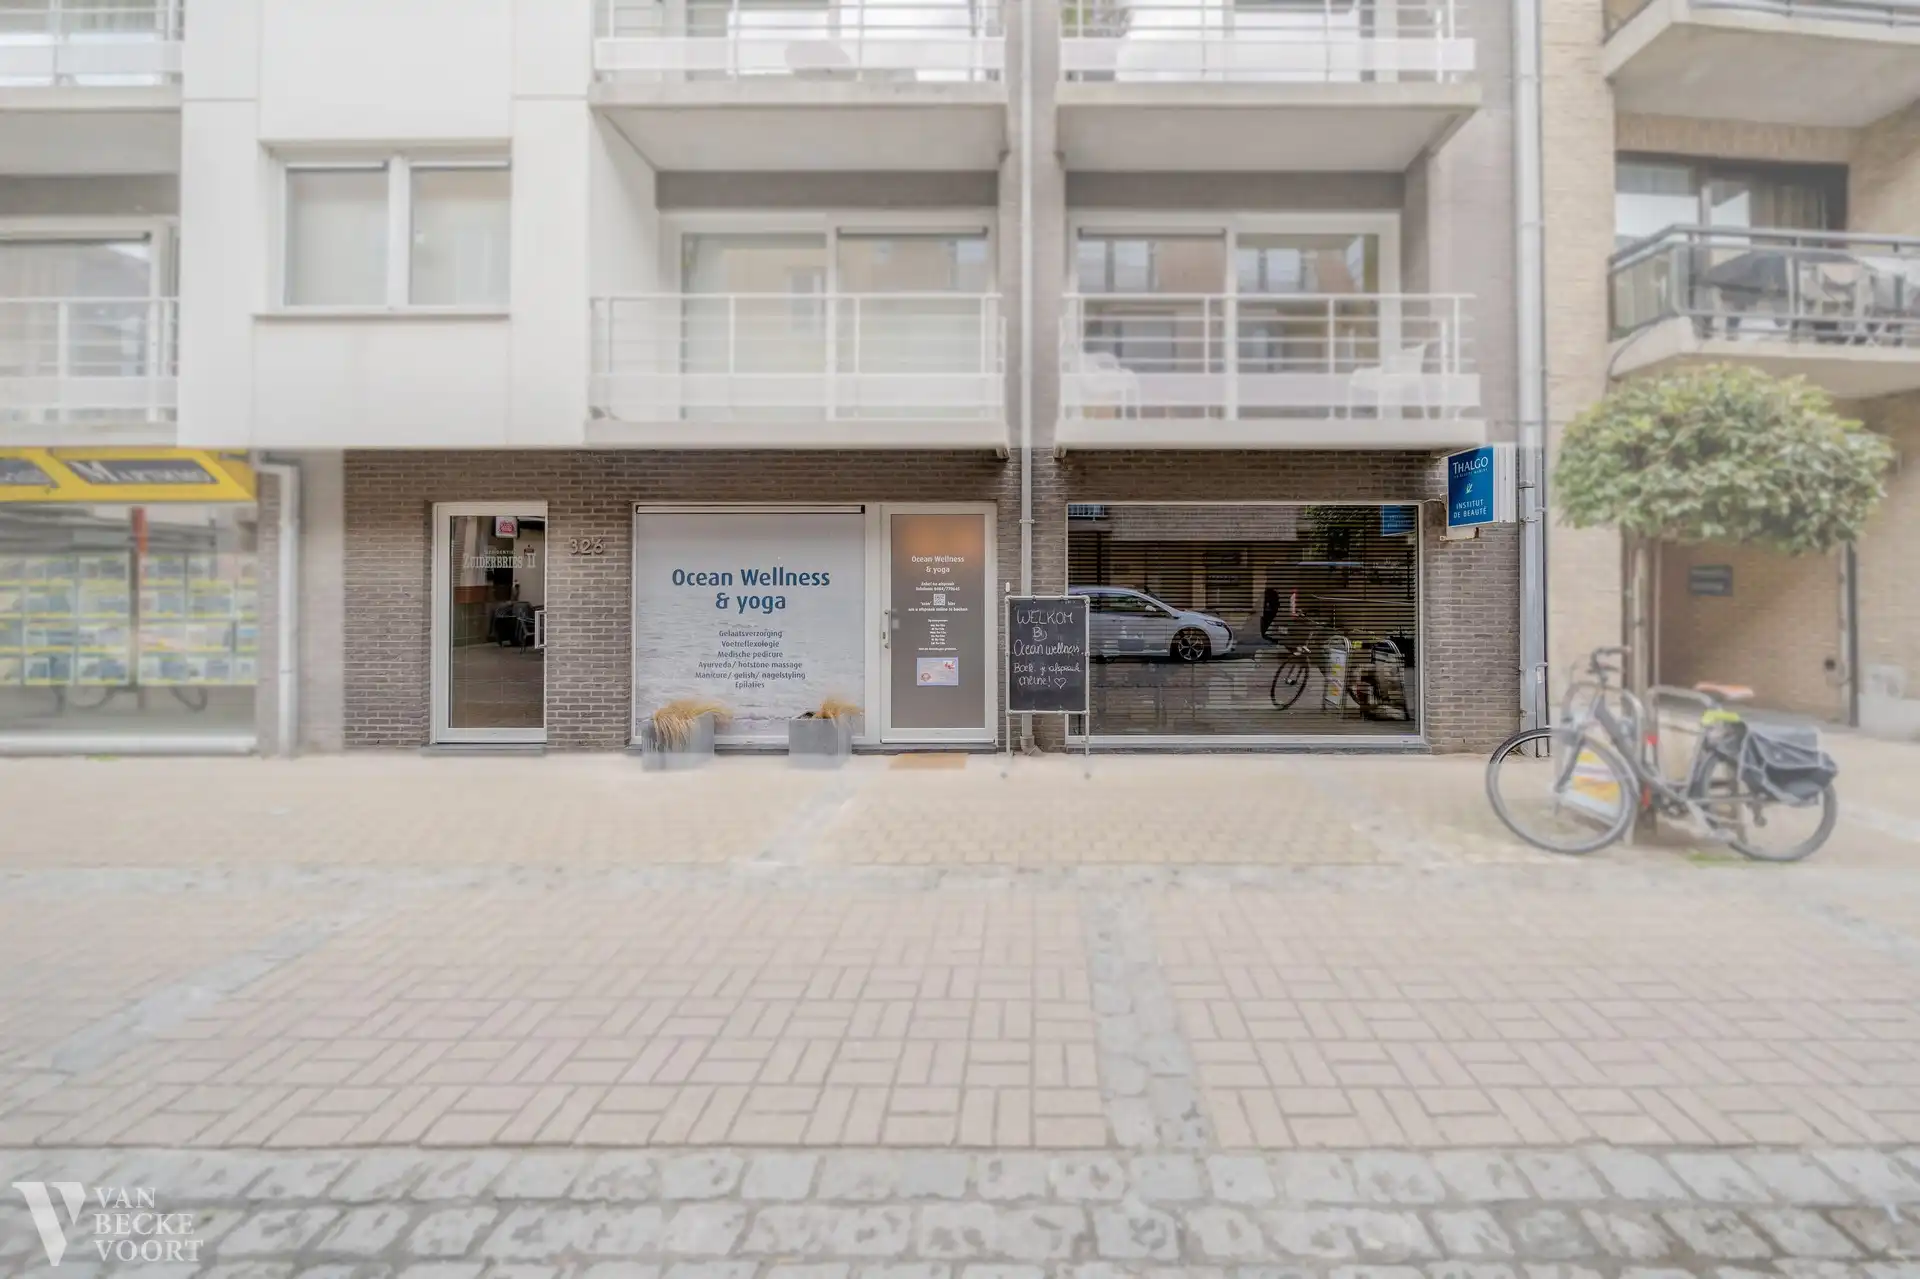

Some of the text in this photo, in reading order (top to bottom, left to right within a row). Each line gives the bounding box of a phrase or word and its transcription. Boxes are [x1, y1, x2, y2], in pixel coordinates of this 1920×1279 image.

[1453, 456, 1488, 475] THALGO
[1456, 499, 1483, 509] INSTITUT
[1463, 506, 1487, 517] BEAUTÉ
[569, 538, 605, 555] 326
[911, 554, 965, 563] Ocean Wellness
[925, 565, 950, 575] & yoga
[672, 566, 830, 586] Ocean Wellness
[716, 592, 786, 614] & yoga
[1017, 609, 1074, 625] WELKOM
[718, 630, 783, 638] Gelaatsverzorging
[721, 640, 780, 648] Voetreflexologie
[1013, 639, 1080, 656] Ocean wellness
[752, 651, 784, 659] pedicure
[698, 661, 737, 669] Ayurveda/
[734, 671, 760, 680] gelish/
[762, 671, 806, 680] nagelstyling
[735, 681, 765, 689] Epilaties
